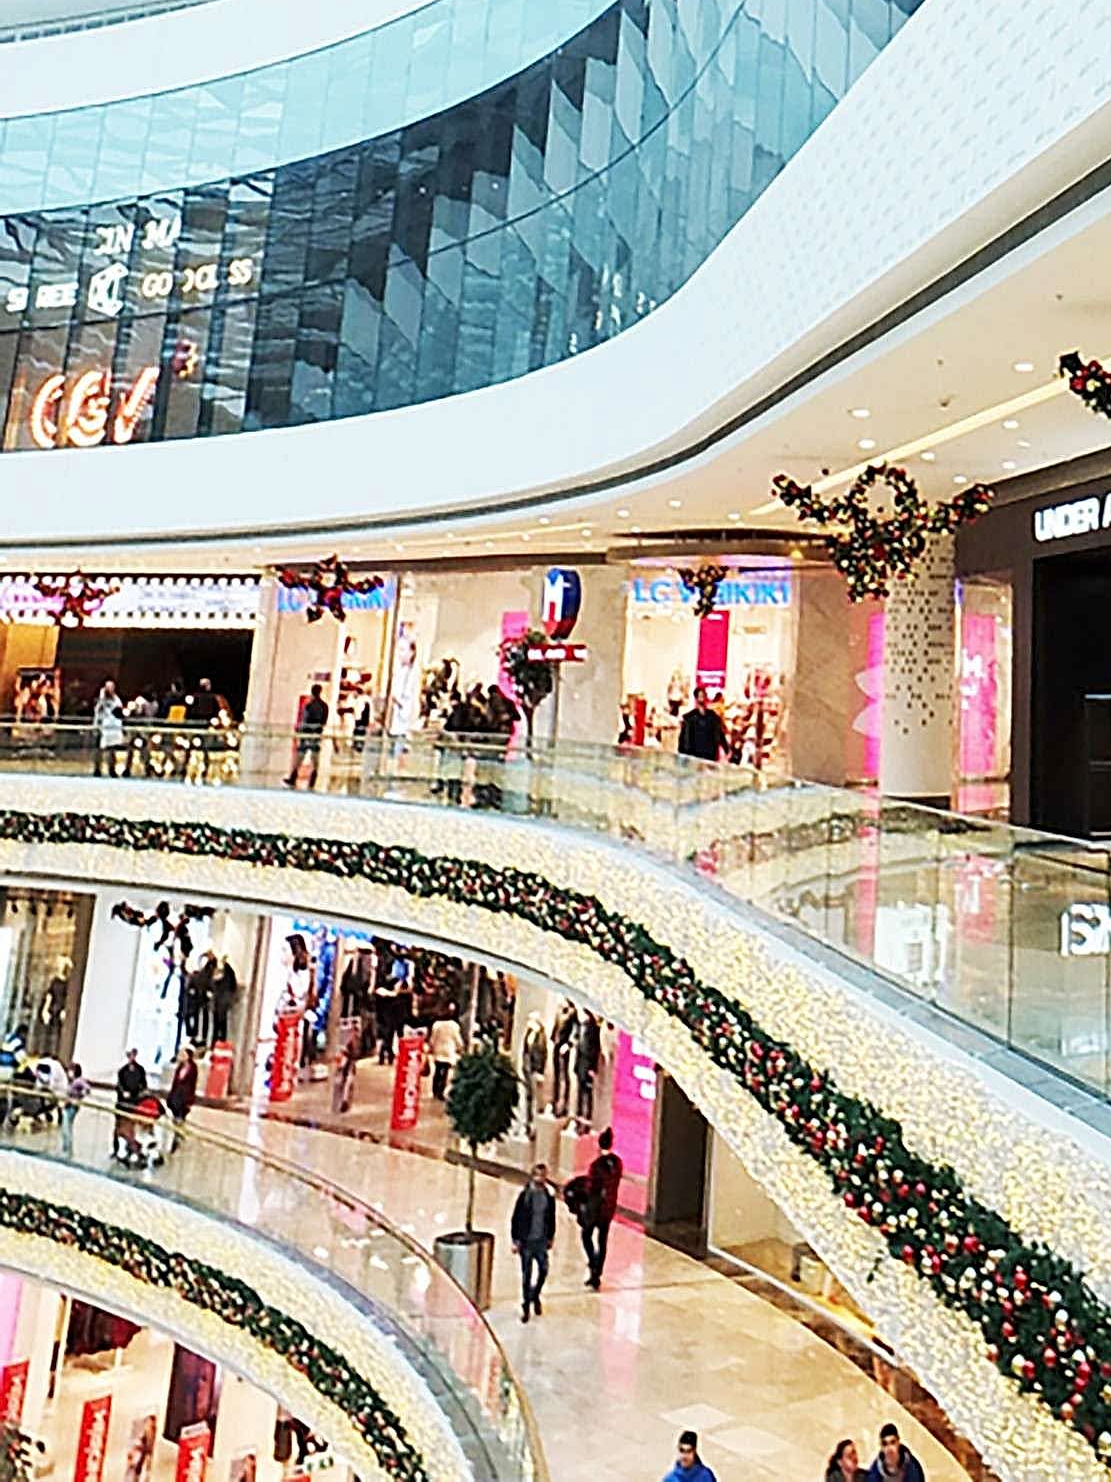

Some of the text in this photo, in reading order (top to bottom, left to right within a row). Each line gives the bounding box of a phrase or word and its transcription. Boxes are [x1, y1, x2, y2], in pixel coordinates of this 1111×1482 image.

[30, 367, 161, 449] CGV
[1034, 497, 1100, 543] UNDER
[677, 580, 789, 605] WIKIKI
